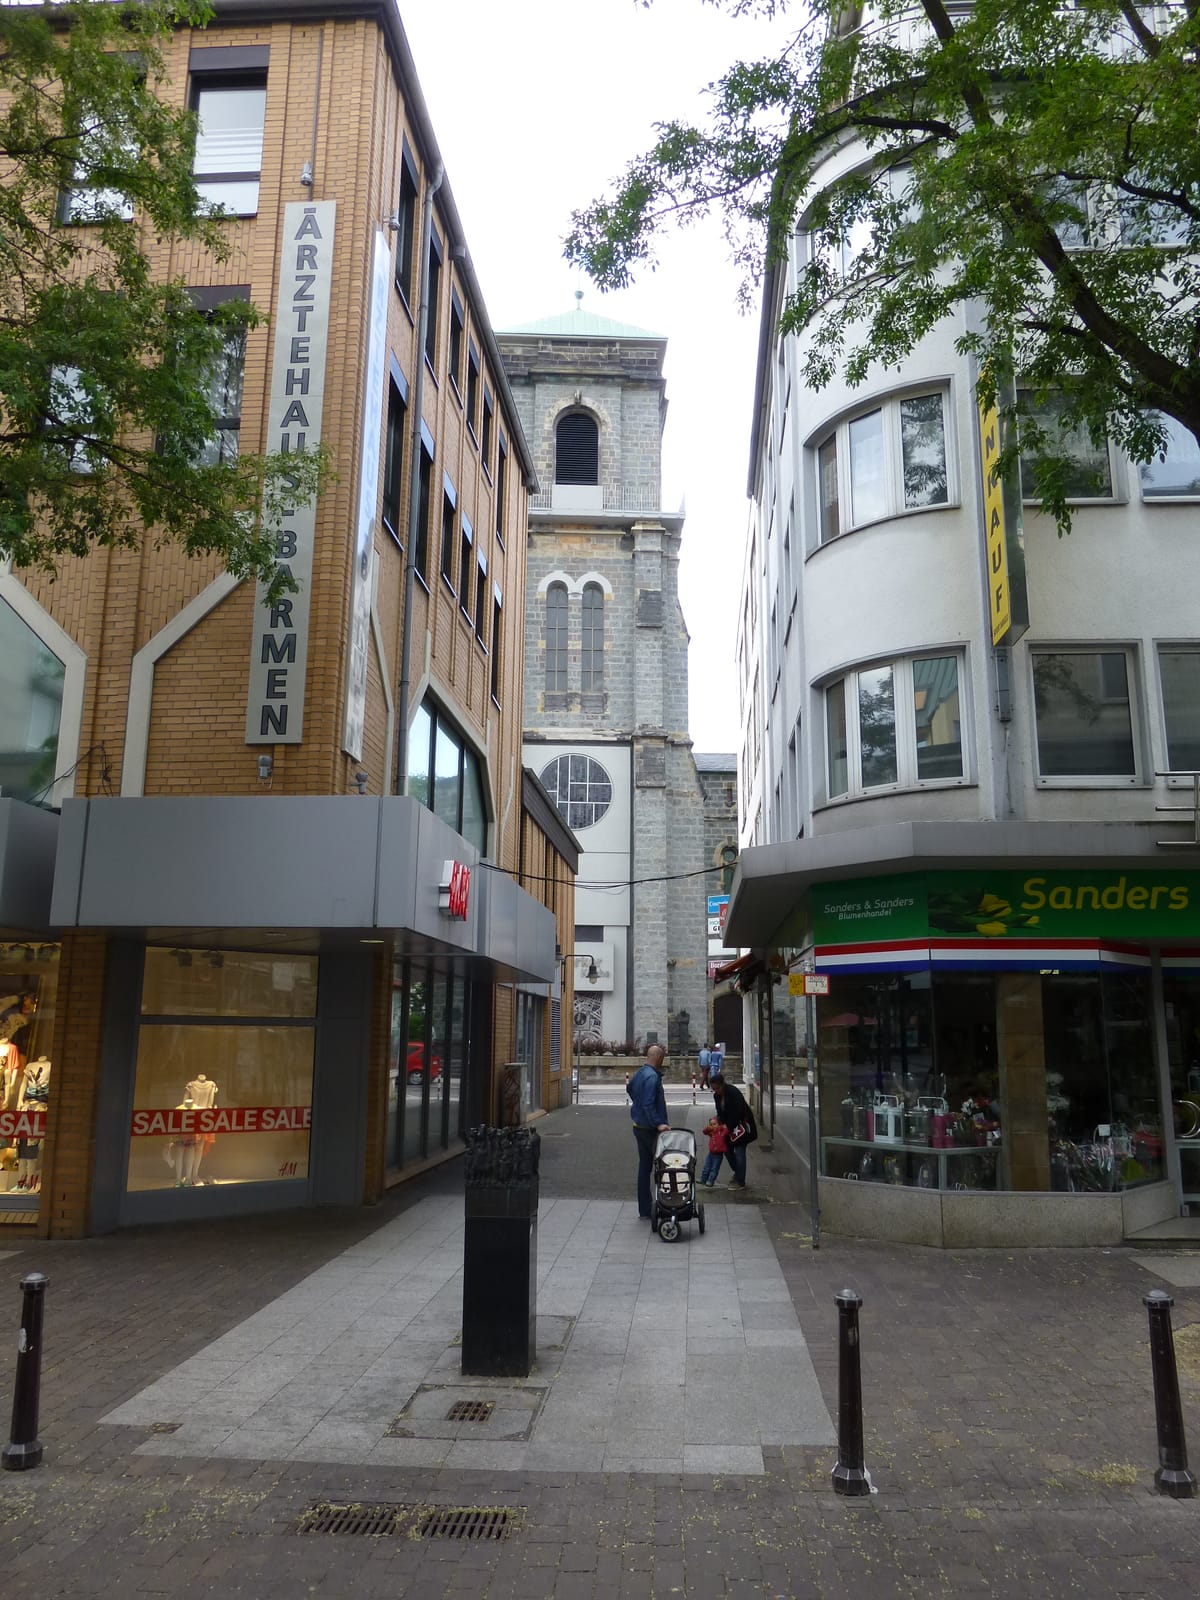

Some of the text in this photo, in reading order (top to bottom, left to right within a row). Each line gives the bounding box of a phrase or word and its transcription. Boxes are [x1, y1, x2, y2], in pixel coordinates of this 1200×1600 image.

[1021, 876, 1189, 910] Sanders
[824, 897, 914, 915] Sanders & Sanders
[838, 908, 892, 920] Blumenhandel
[132, 1108, 311, 1135] SALE SALE SALE
